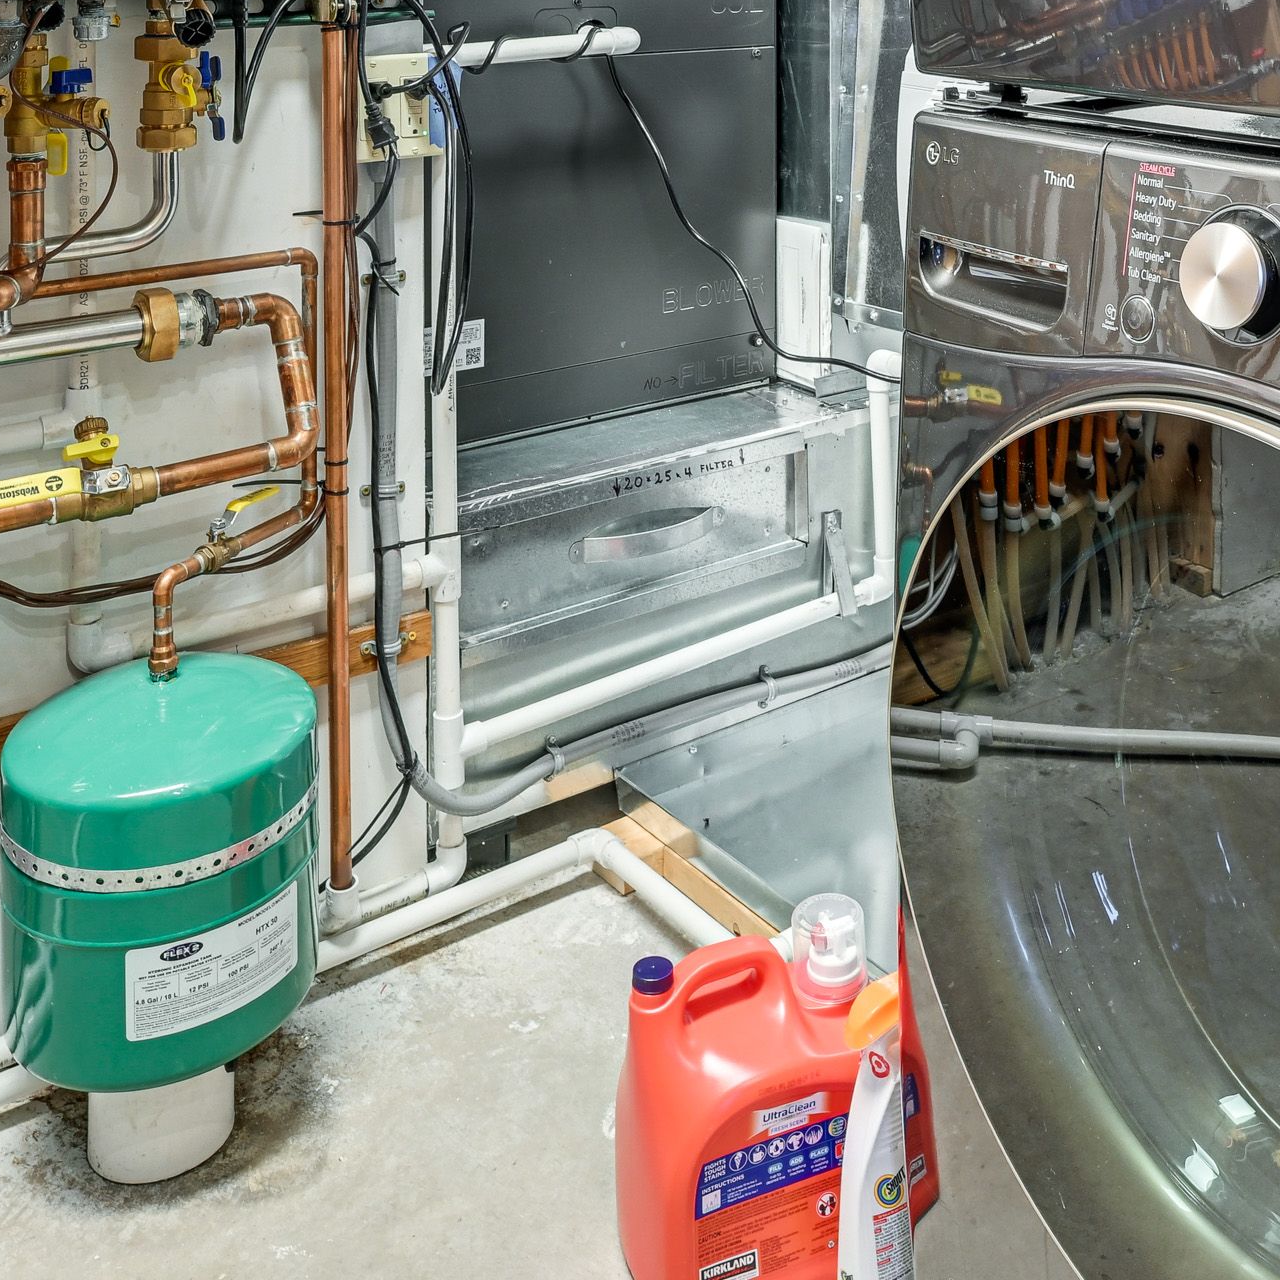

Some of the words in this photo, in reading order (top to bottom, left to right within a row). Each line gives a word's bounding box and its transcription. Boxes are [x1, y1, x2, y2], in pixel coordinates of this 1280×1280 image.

[943, 146, 960, 166] LG
[1140, 163, 1157, 173] STEAM
[1158, 166, 1176, 175] CYCLE
[1044, 170, 1075, 189] ThinQ
[1137, 175, 1163, 188] Normal
[1135, 192, 1158, 207] Heavy
[1159, 195, 1177, 210] Duty
[80, 206, 88, 223] PSI
[1133, 210, 1162, 226] Bedding
[1131, 228, 1161, 245] Sanitary
[1128, 266, 1140, 278] Tub
[1141, 269, 1161, 283] Clean
[662, 276, 766, 314] BLOWER
[80, 359, 89, 390] SDR21
[679, 350, 765, 389] FILTER
[643, 377, 662, 391] NO
[624, 477, 643, 491] 20
[655, 470, 672, 484] 25
[685, 467, 693, 478] 4
[700, 460, 734, 473] FILTER
[255, 922, 271, 935] HTX
[270, 916, 279, 926] 30
[228, 968, 239, 978] 100
[239, 963, 250, 973] PSI
[189, 986, 197, 994] 12
[198, 982, 210, 991] PSI
[147, 996, 159, 1005] Gal
[763, 1100, 816, 1123] UltraClean
[771, 1124, 788, 1134] FRESH
[789, 1117, 806, 1127] SCENT
[811, 1147, 829, 1158] PLACE
[704, 1159, 727, 1170] FIGHTS
[769, 1164, 782, 1173] FILL
[790, 1157, 803, 1166] ADD
[704, 1165, 726, 1177] TOUGH
[704, 1171, 726, 1183] STAINS
[702, 1174, 745, 1195] INSTRUCTIONS
[886, 1166, 906, 1195] SHOUT
[703, 1255, 754, 1280] KIRKLAND
